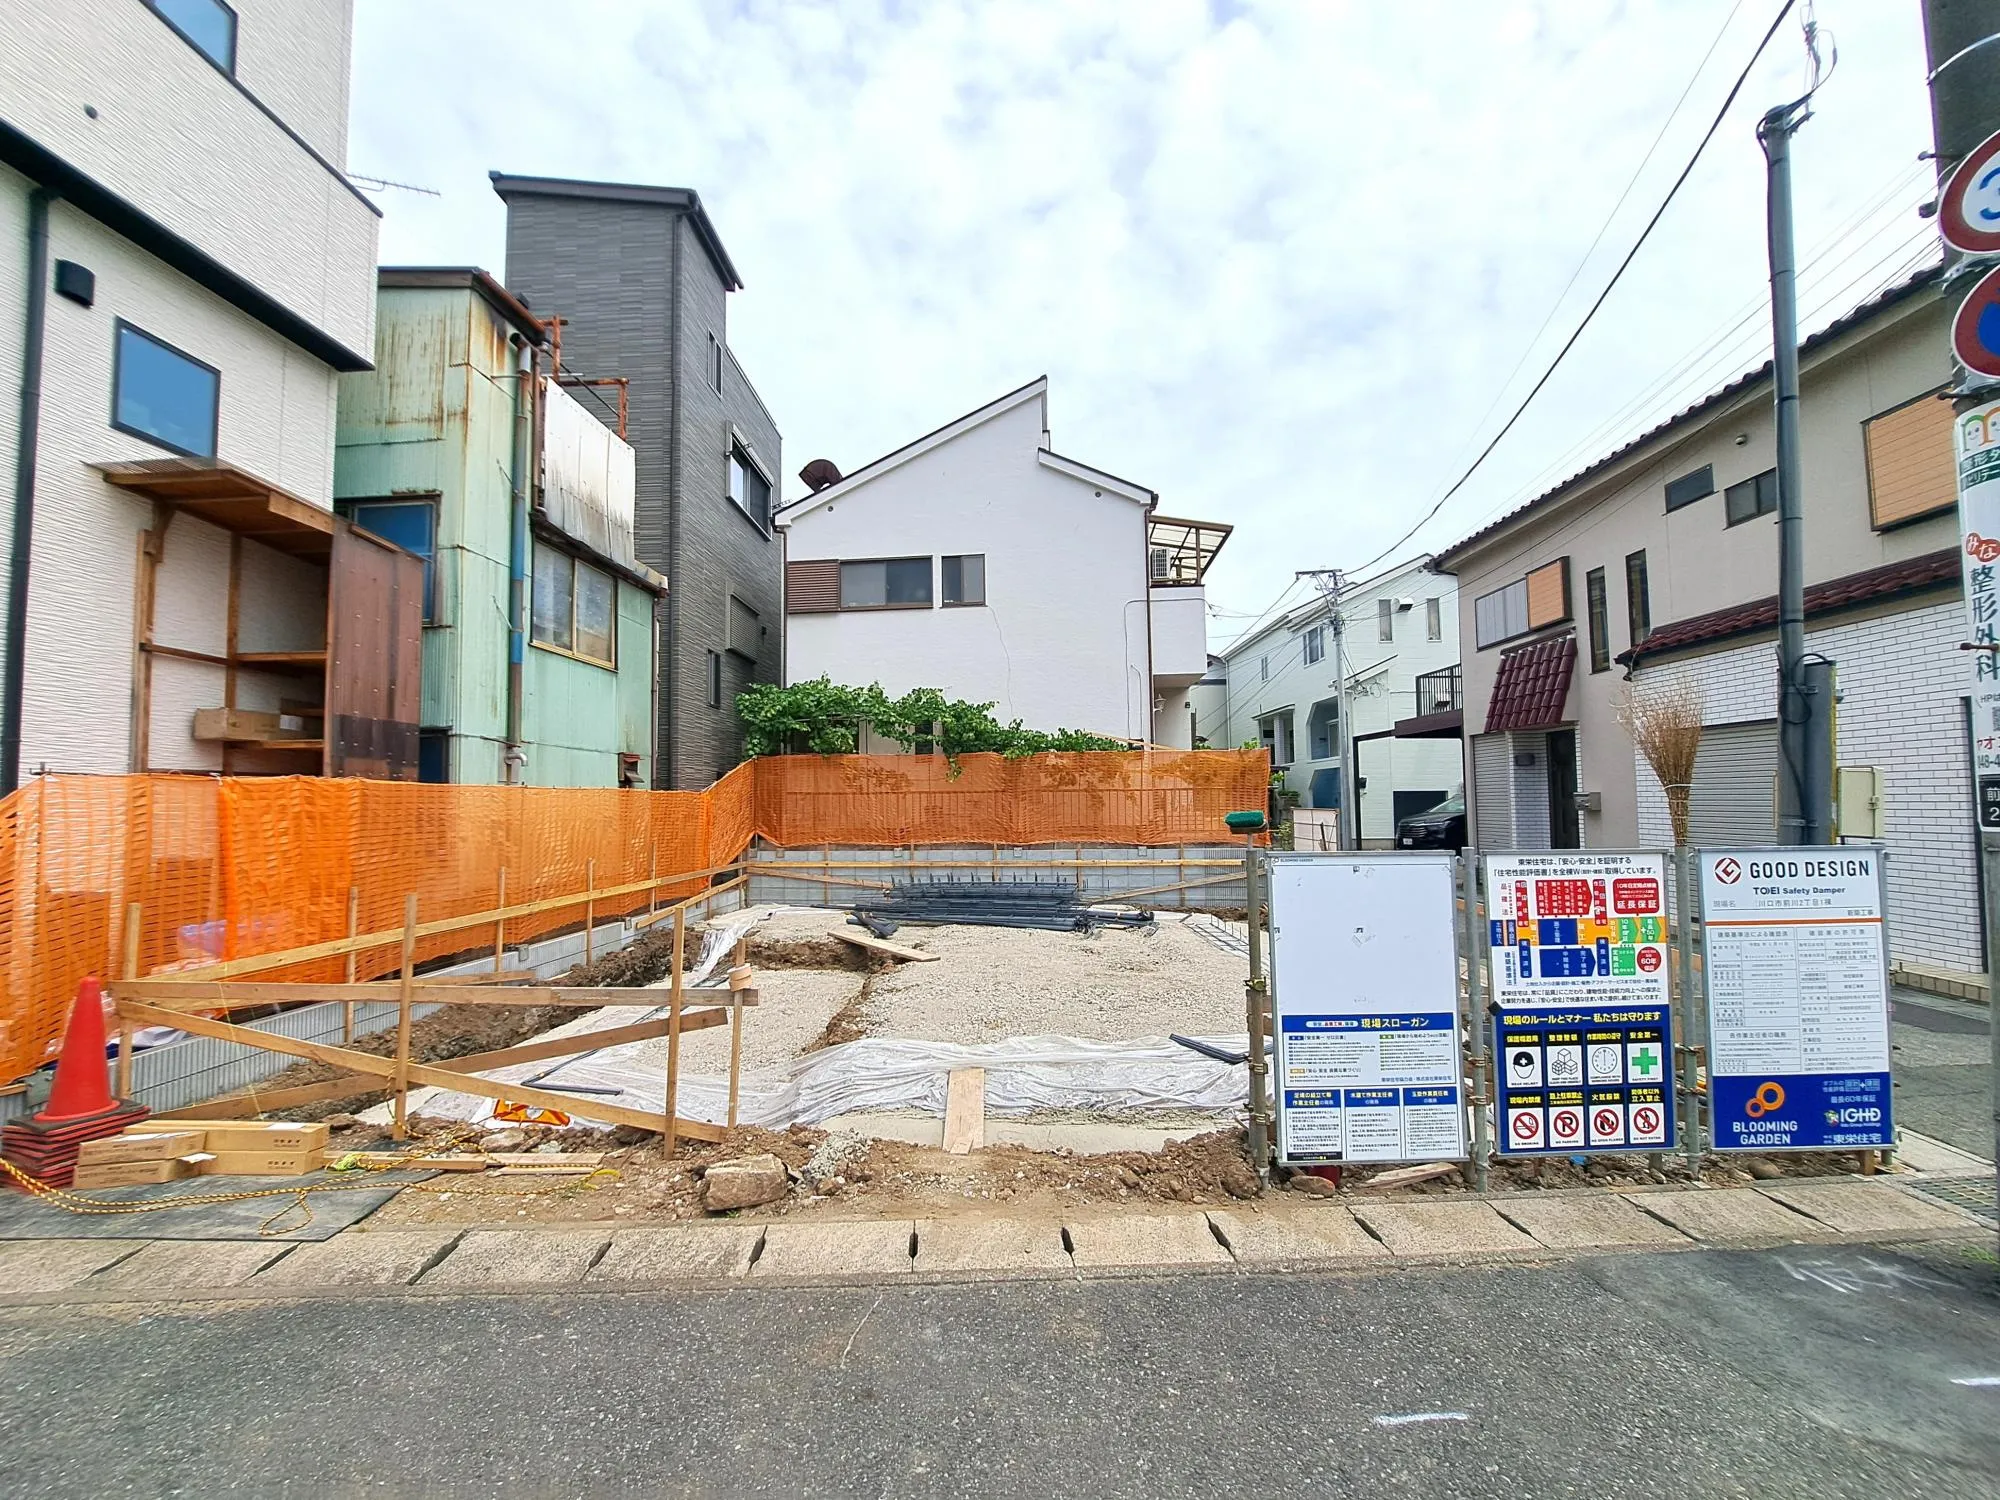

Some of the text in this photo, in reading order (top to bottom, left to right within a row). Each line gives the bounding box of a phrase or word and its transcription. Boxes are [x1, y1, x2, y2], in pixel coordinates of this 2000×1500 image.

[1750, 860, 1869, 878] GOOD DESIGN
[1783, 887, 1810, 895] Safety
[1812, 887, 1846, 895] Damper
[1733, 1120, 1798, 1133] BLOOMING
[1740, 1133, 1791, 1144] GARDEN
